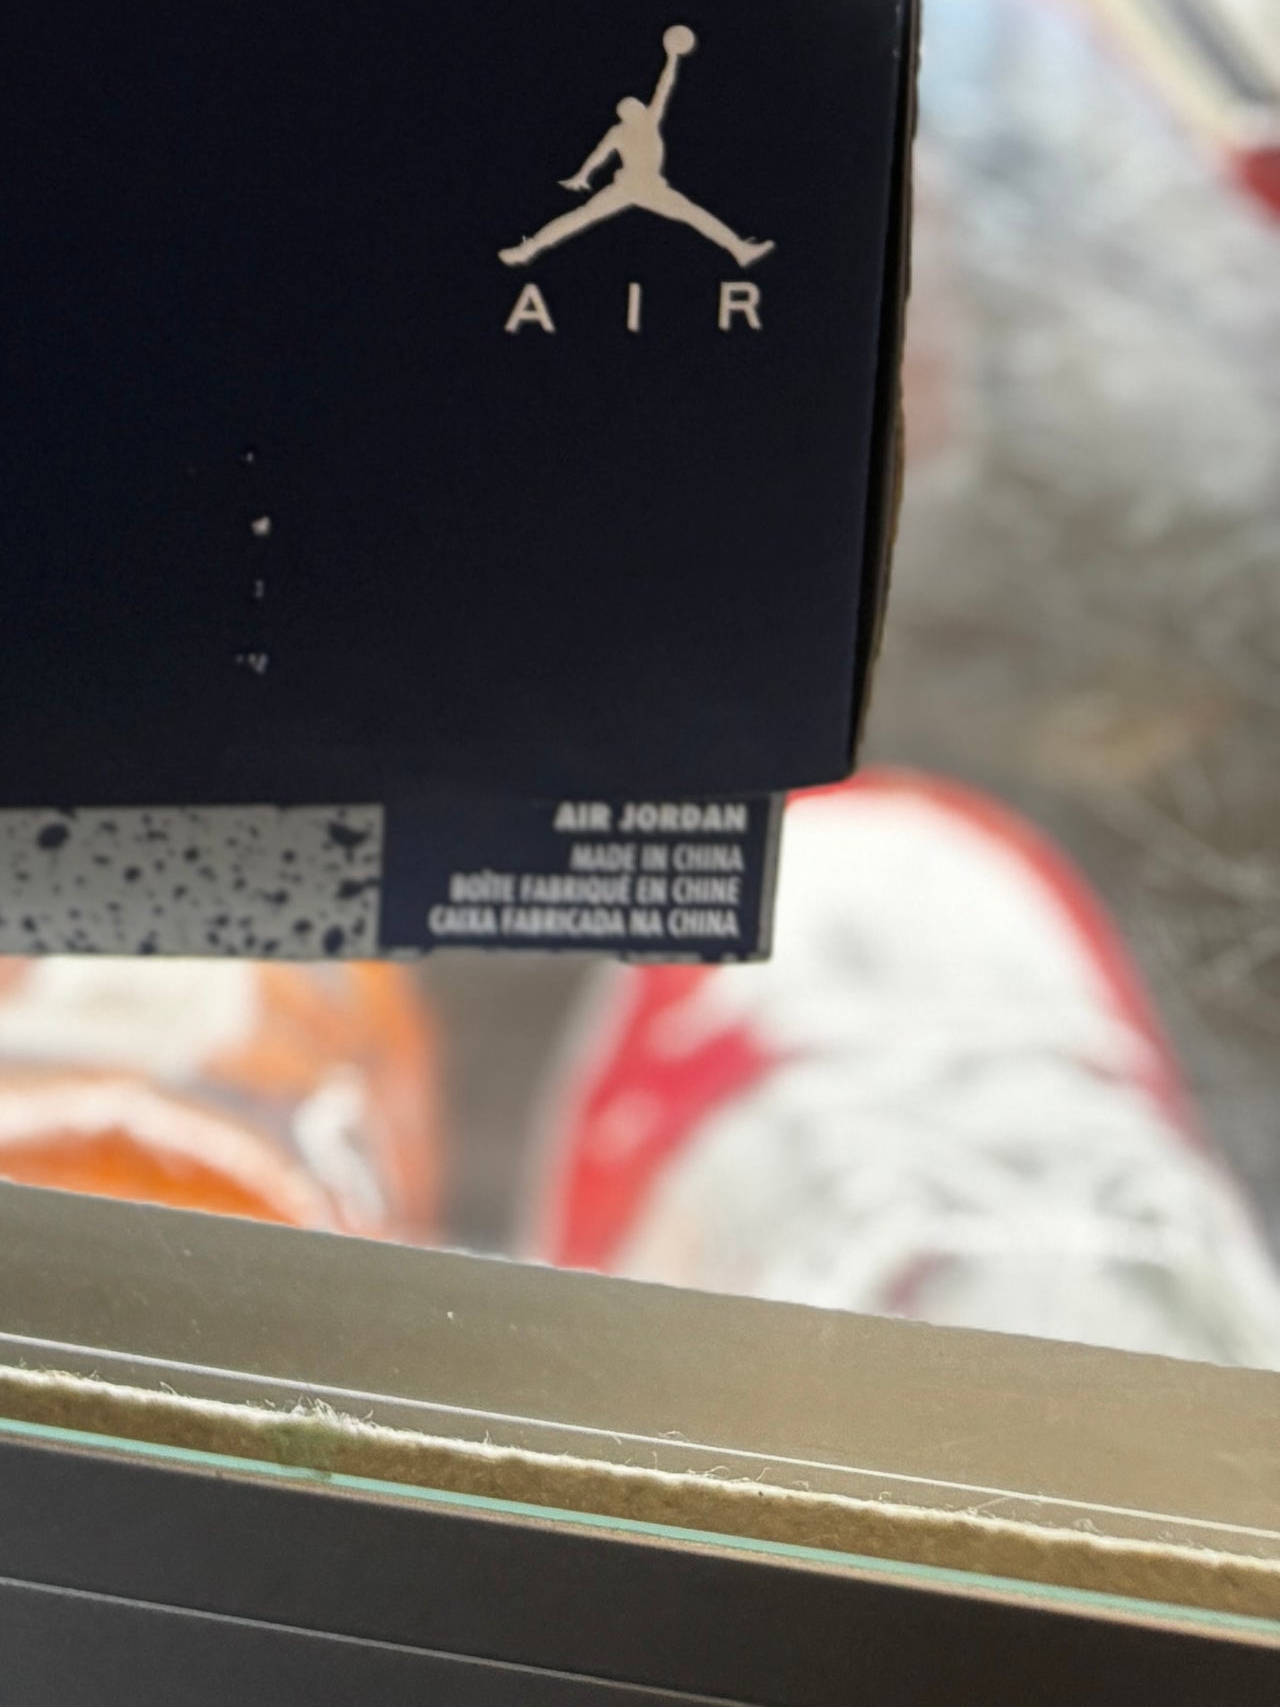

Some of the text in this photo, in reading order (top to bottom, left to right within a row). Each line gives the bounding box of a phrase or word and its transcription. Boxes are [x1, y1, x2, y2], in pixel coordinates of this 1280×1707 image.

[504, 281, 764, 334] AIR
[553, 802, 748, 833] AIR JORDAN
[570, 843, 744, 874] MADE IN CHINA
[636, 875, 668, 905] EN
[671, 875, 742, 906] CHINE
[428, 904, 740, 938] CAIXA FABRICADA NA CHINA
